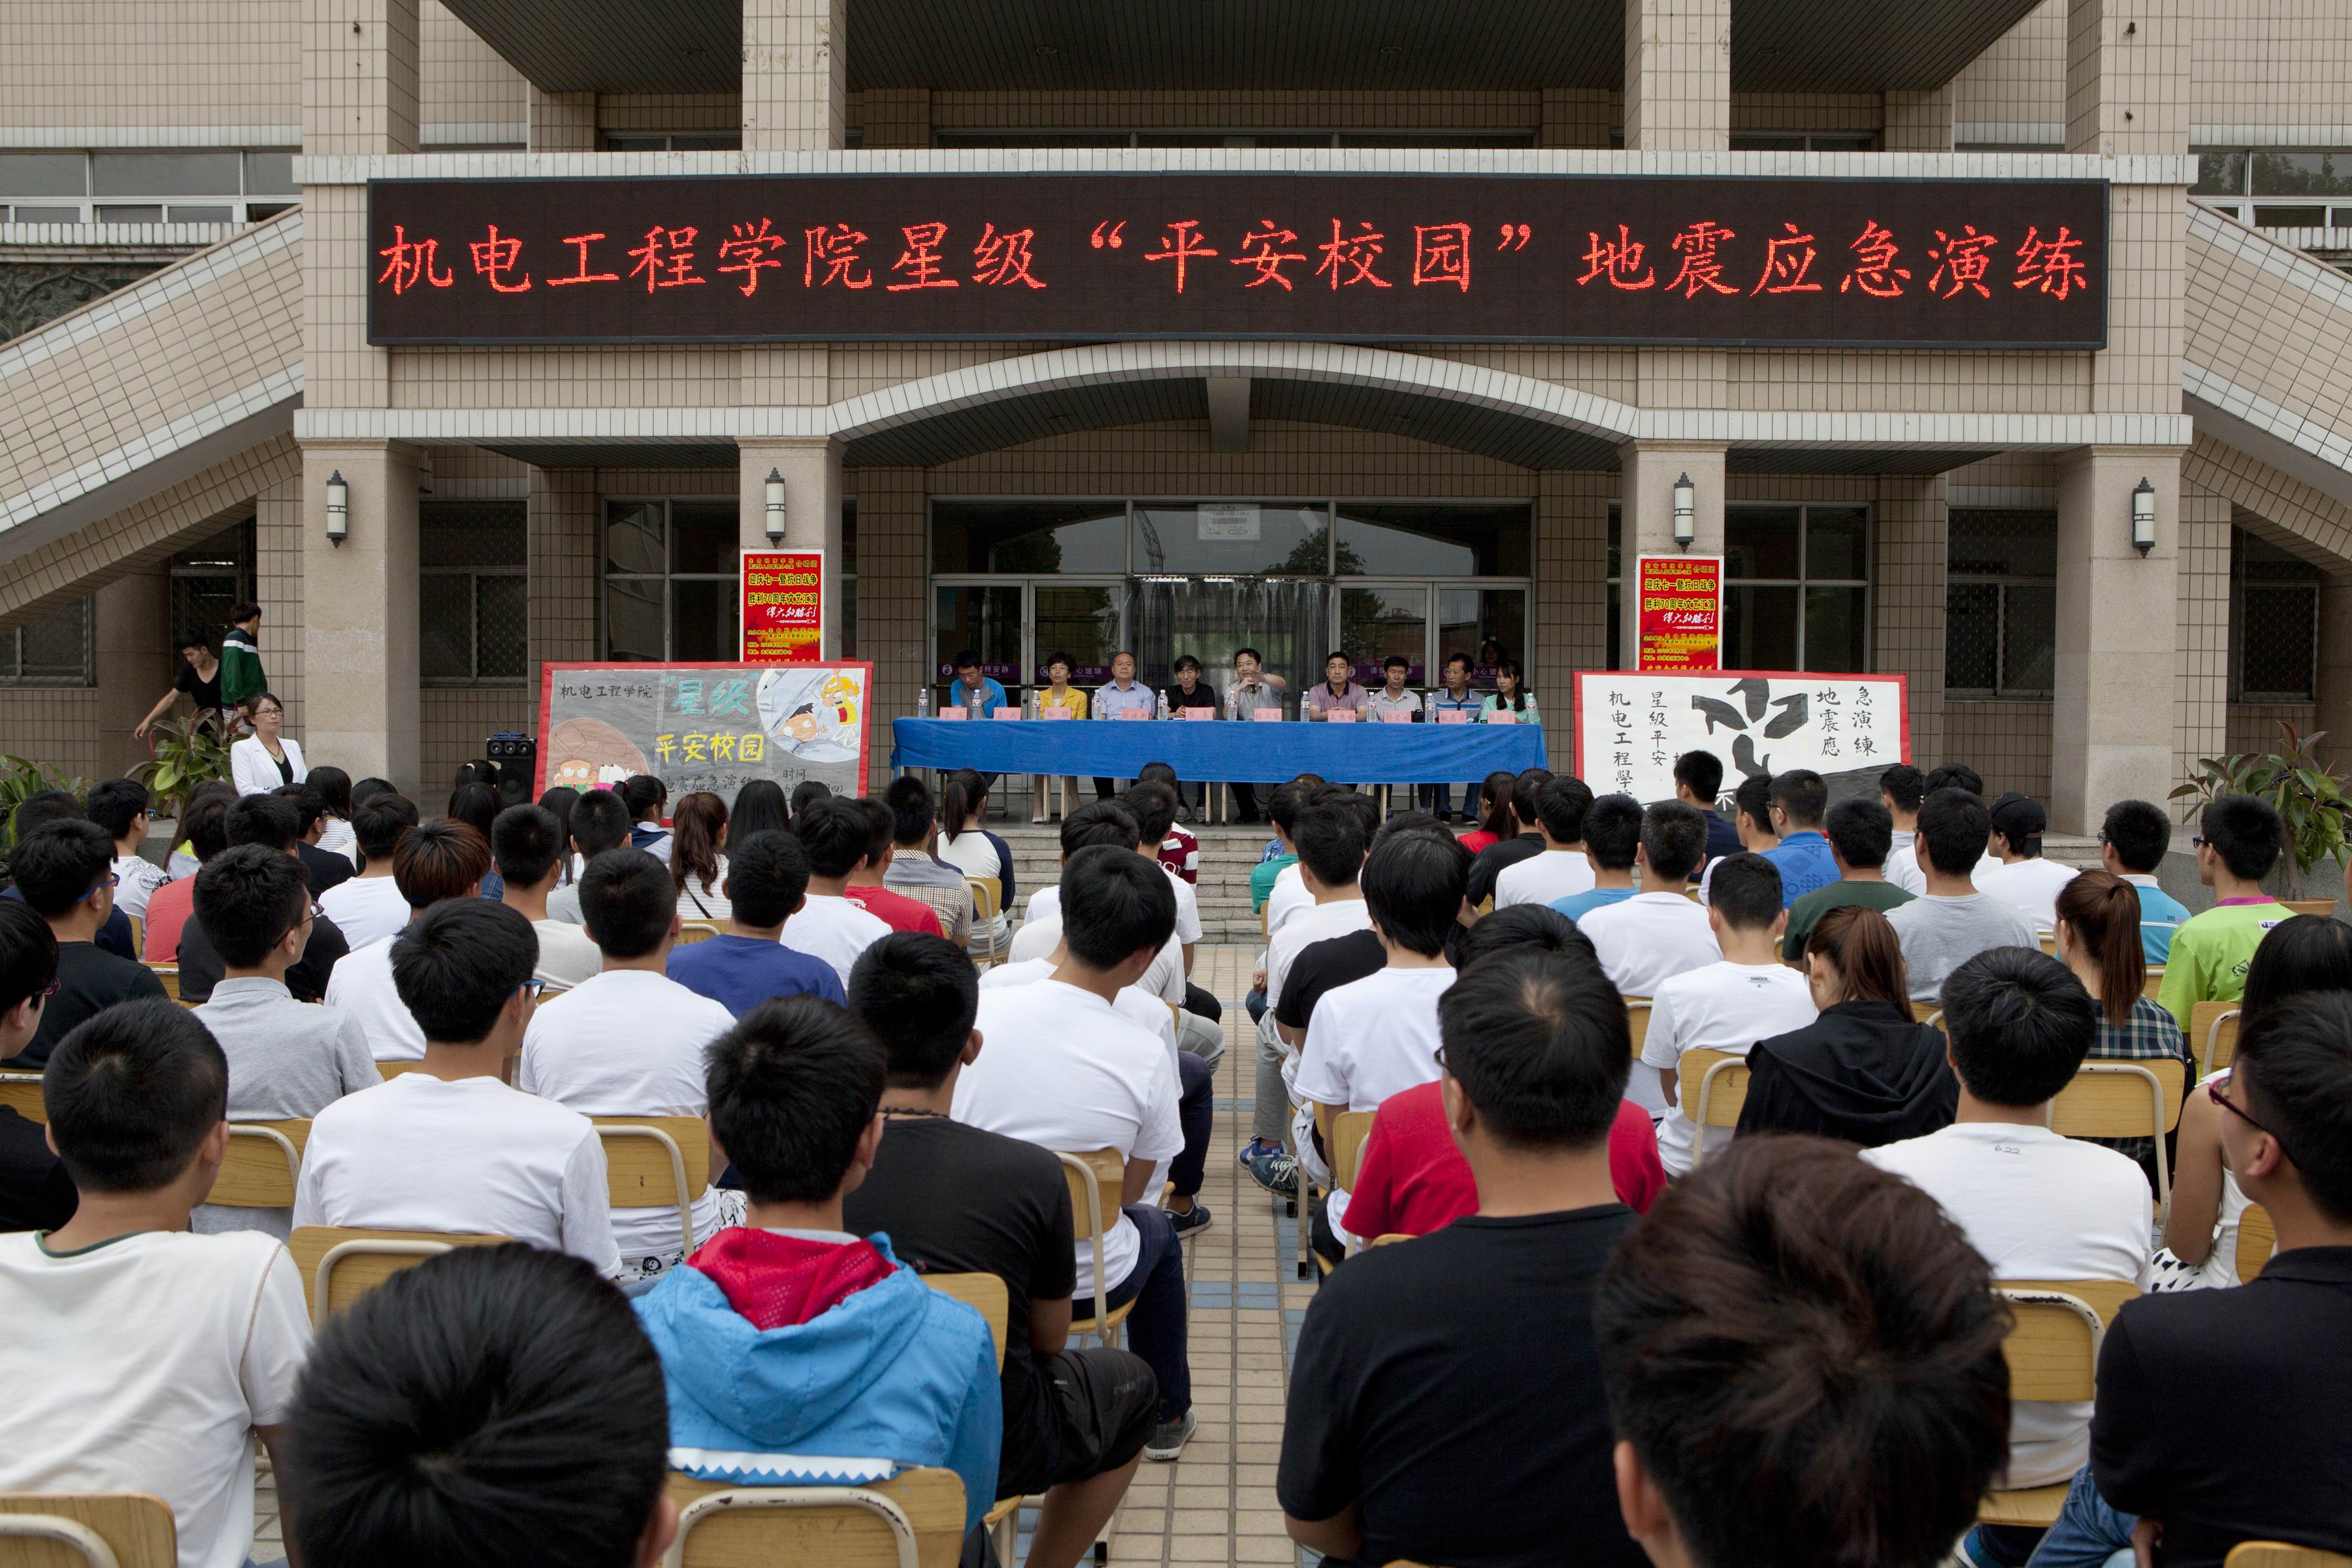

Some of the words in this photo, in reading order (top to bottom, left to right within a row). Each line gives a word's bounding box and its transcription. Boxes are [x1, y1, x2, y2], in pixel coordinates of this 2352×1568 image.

[749, 573, 818, 585] 迎庆七一暨抗日战争
[1645, 578, 1716, 591] 迎庆七一暨抗日战争
[748, 593, 817, 604] 胜利70周年文艺汇演
[1645, 598, 1716, 611] 胜利70周年文艺汇演
[985, 665, 1009, 674] 持安静
[561, 684, 653, 699] 机电工程学院
[1816, 686, 1841, 757] 地震應
[1852, 686, 1878, 757] 急演練
[1649, 691, 1669, 766] 星級平安
[656, 730, 764, 764] 平安校园
[1995, 1145, 2021, 1155] 6.22
